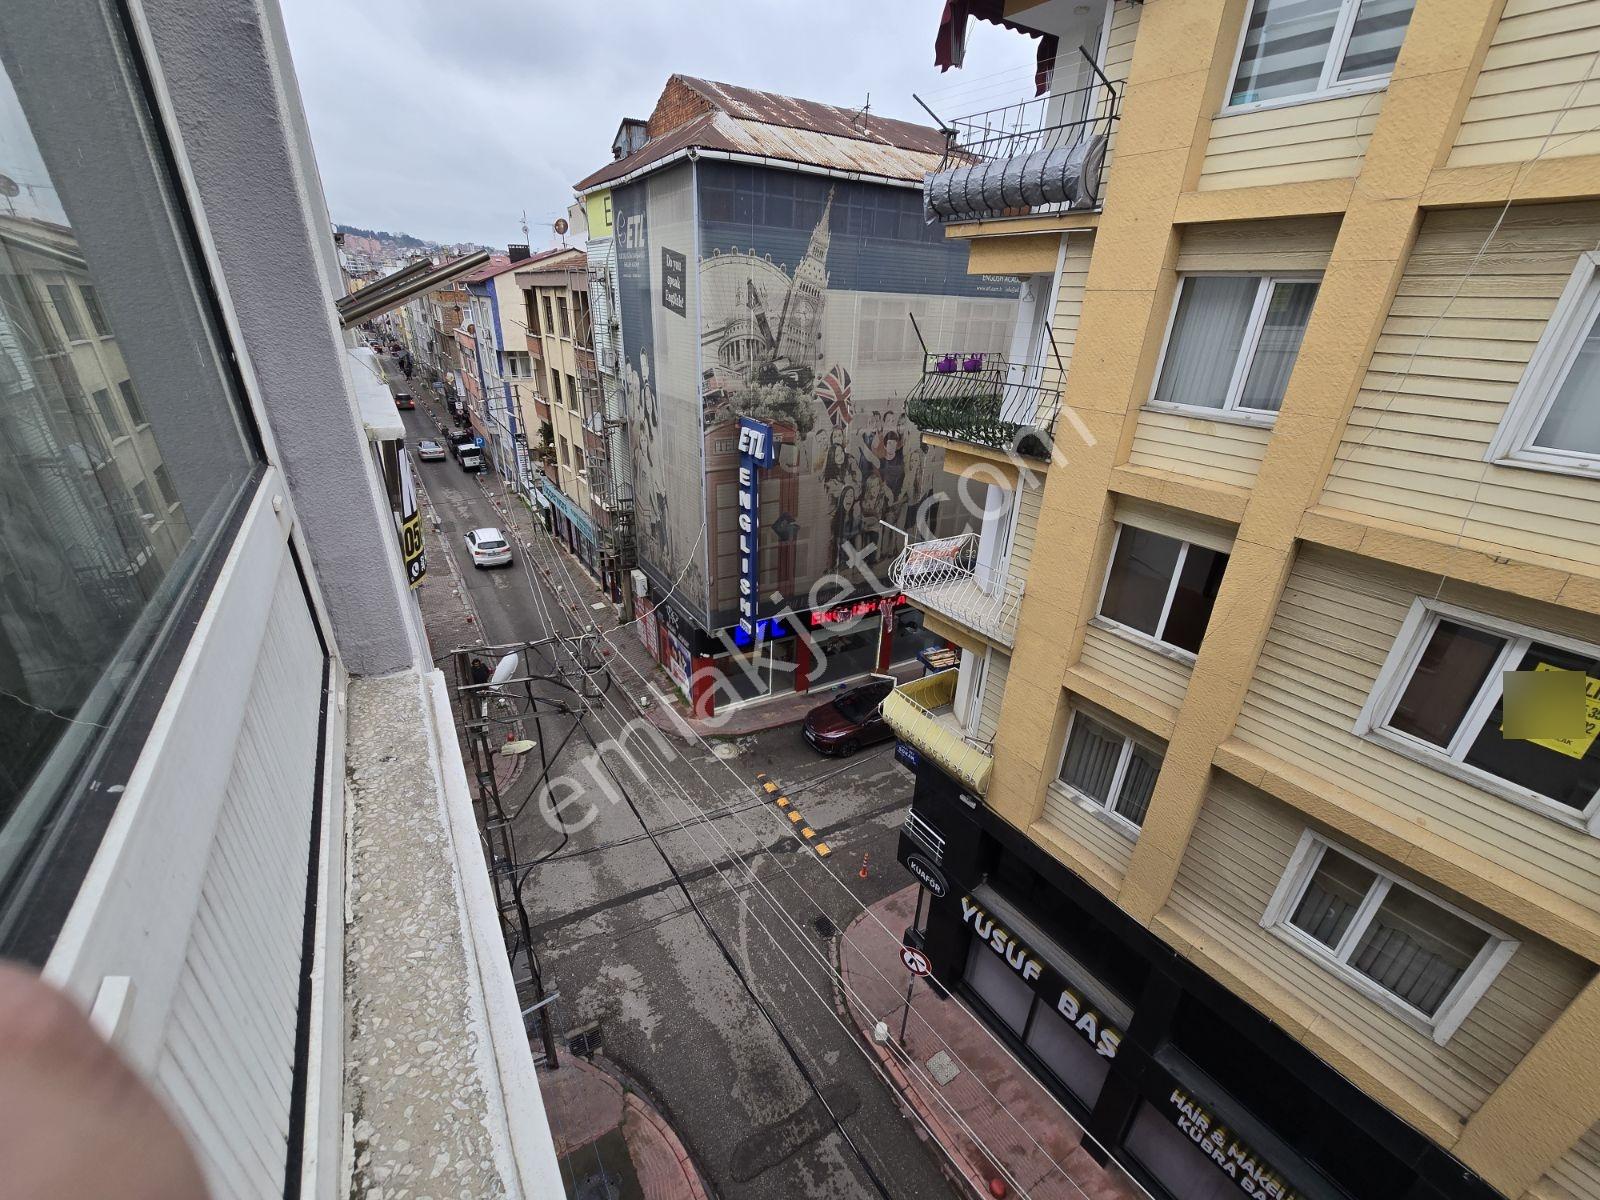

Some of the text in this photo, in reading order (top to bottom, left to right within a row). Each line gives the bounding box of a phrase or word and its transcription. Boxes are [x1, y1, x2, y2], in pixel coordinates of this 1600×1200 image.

[738, 426, 765, 460] ETL
[738, 467, 752, 617] ENGLISH
[910, 861, 941, 894] KUAFÖR
[961, 895, 1043, 981] YUSUF
[1177, 1115, 1236, 1179] KÜBRA
[1210, 1128, 1226, 1149] &
